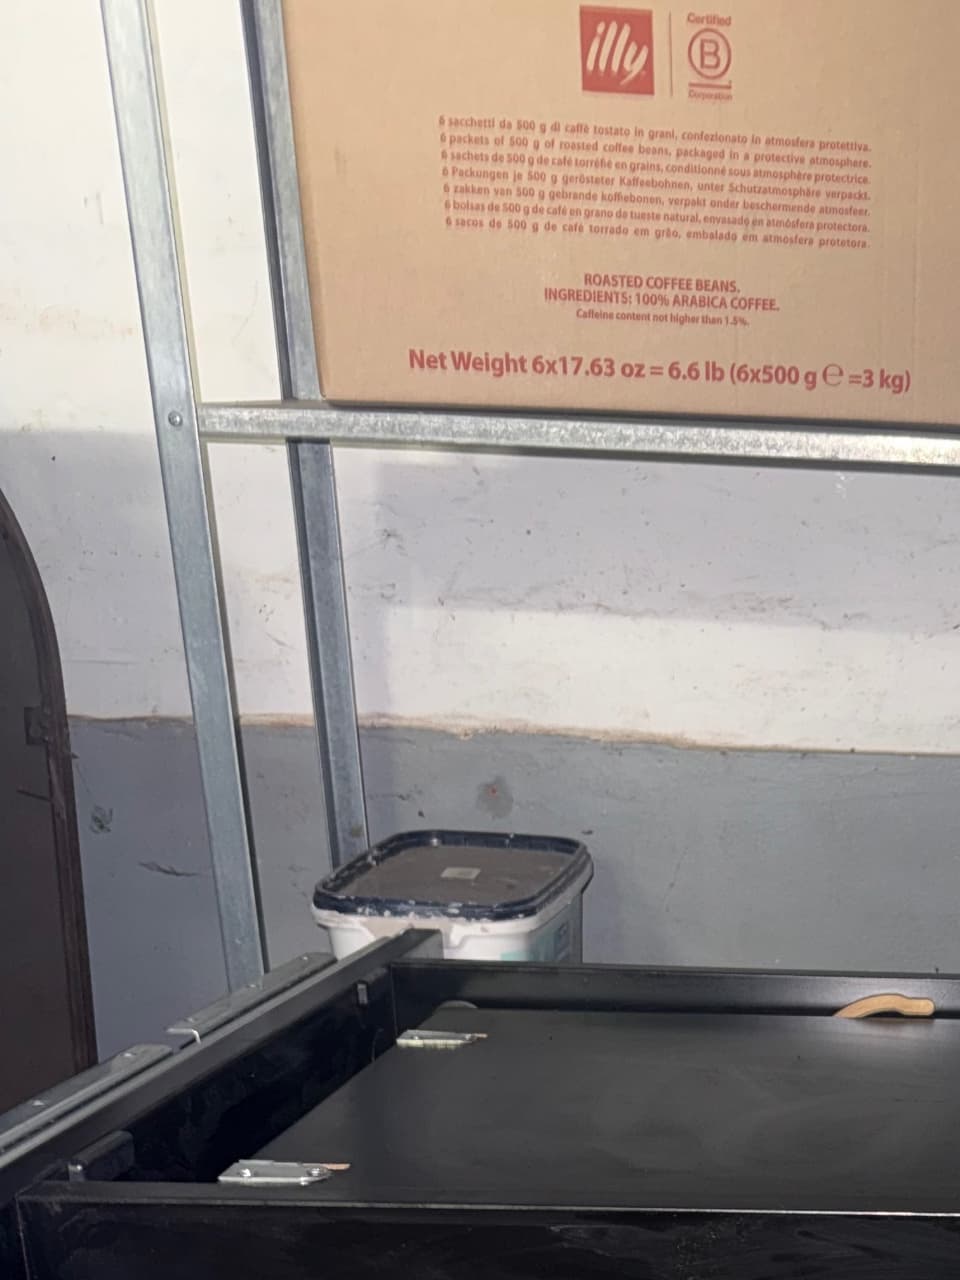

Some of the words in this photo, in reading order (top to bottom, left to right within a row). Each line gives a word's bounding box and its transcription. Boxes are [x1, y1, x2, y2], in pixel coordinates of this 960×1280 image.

[687, 12, 732, 27] Certified
[586, 21, 648, 86] illy
[700, 38, 721, 70] B
[688, 90, 733, 102] Corporation
[438, 115, 446, 125] 6
[447, 115, 495, 128] sacchetti
[498, 118, 512, 129] da
[515, 120, 536, 131] 500
[538, 123, 547, 134] g
[549, 122, 560, 132] di
[592, 124, 630, 137] tostato
[633, 127, 644, 138] in
[647, 128, 678, 142] grani,
[680, 130, 748, 144] confezionato
[750, 134, 761, 145] in
[764, 135, 815, 148] atmosfera
[818, 138, 872, 154] protettiva.
[439, 132, 446, 142] 6
[448, 132, 490, 148] packets
[493, 135, 504, 146] of
[508, 136, 528, 147] 500
[532, 140, 540, 151] g
[544, 138, 555, 149] of
[558, 139, 598, 151] roasted
[602, 141, 634, 153] coffee
[637, 143, 672, 156] beans,
[675, 146, 725, 161] packaged
[728, 149, 739, 160] in
[743, 152, 750, 160] a
[753, 150, 805, 166] protective
[808, 154, 872, 170] atmosphere.
[440, 149, 448, 160] 6
[450, 150, 489, 162] sachets
[490, 152, 504, 163] de
[506, 153, 526, 164] 500
[527, 157, 534, 168] g
[536, 155, 550, 166] de
[614, 162, 628, 170] en
[628, 160, 664, 175] grains,
[727, 168, 751, 177] sous
[813, 171, 871, 187] protectrice.
[441, 166, 449, 176] 6
[451, 166, 509, 182] Packungen
[512, 172, 523, 183] je
[526, 171, 546, 182] 500
[550, 174, 558, 185] g
[618, 176, 693, 190] Kaffeebohnen,
[696, 180, 725, 192] unter
[824, 188, 871, 203] verpackt.
[442, 182, 450, 193] 6
[453, 183, 490, 195] zakken
[493, 187, 512, 196] van
[515, 186, 535, 198] 500
[537, 190, 545, 201] g
[548, 188, 598, 204] gebrande
[667, 195, 706, 210] verpakt
[709, 197, 739, 209] onder
[742, 199, 816, 214] beschermende
[818, 204, 870, 217] atmosfeer.
[444, 199, 451, 209] 6
[452, 199, 485, 211] bolsas
[486, 201, 500, 212] de
[502, 202, 521, 213] 500
[522, 205, 530, 217] g
[531, 204, 544, 215] de
[568, 208, 582, 217] en
[583, 209, 614, 221] grano
[614, 208, 628, 219] de
[629, 209, 661, 221] tueste
[662, 211, 702, 223] natural,
[702, 213, 750, 226] envasado
[750, 218, 764, 227] en
[816, 220, 870, 235] protectora.
[445, 215, 452, 226] 6
[455, 218, 484, 228] sacos
[488, 218, 502, 229] de
[507, 219, 527, 230] 500
[531, 222, 538, 233] g
[543, 221, 557, 232] de
[588, 223, 628, 236] torrado
[633, 228, 649, 237] em
[686, 229, 737, 241] embalado
[742, 234, 758, 243] em
[762, 233, 814, 246] atmosfera
[818, 236, 869, 251] protetora.
[544, 288, 633, 304] INGREDIENTS:
[635, 292, 670, 306] 100%
[672, 294, 728, 309] ARABICA
[730, 297, 780, 311] COFFEE.
[583, 273, 643, 288] ROASTED
[644, 276, 693, 291] COFFEE
[694, 279, 740, 293] BEANS.
[408, 349, 448, 369] Net
[450, 351, 528, 377] Weight
[531, 354, 616, 376] 6x17.63
[621, 363, 646, 377] oz
[668, 360, 701, 380] 6.6
[705, 362, 725, 381] lb
[730, 363, 800, 389] (6x500
[804, 371, 818, 389] g
[879, 369, 912, 393] kg)
